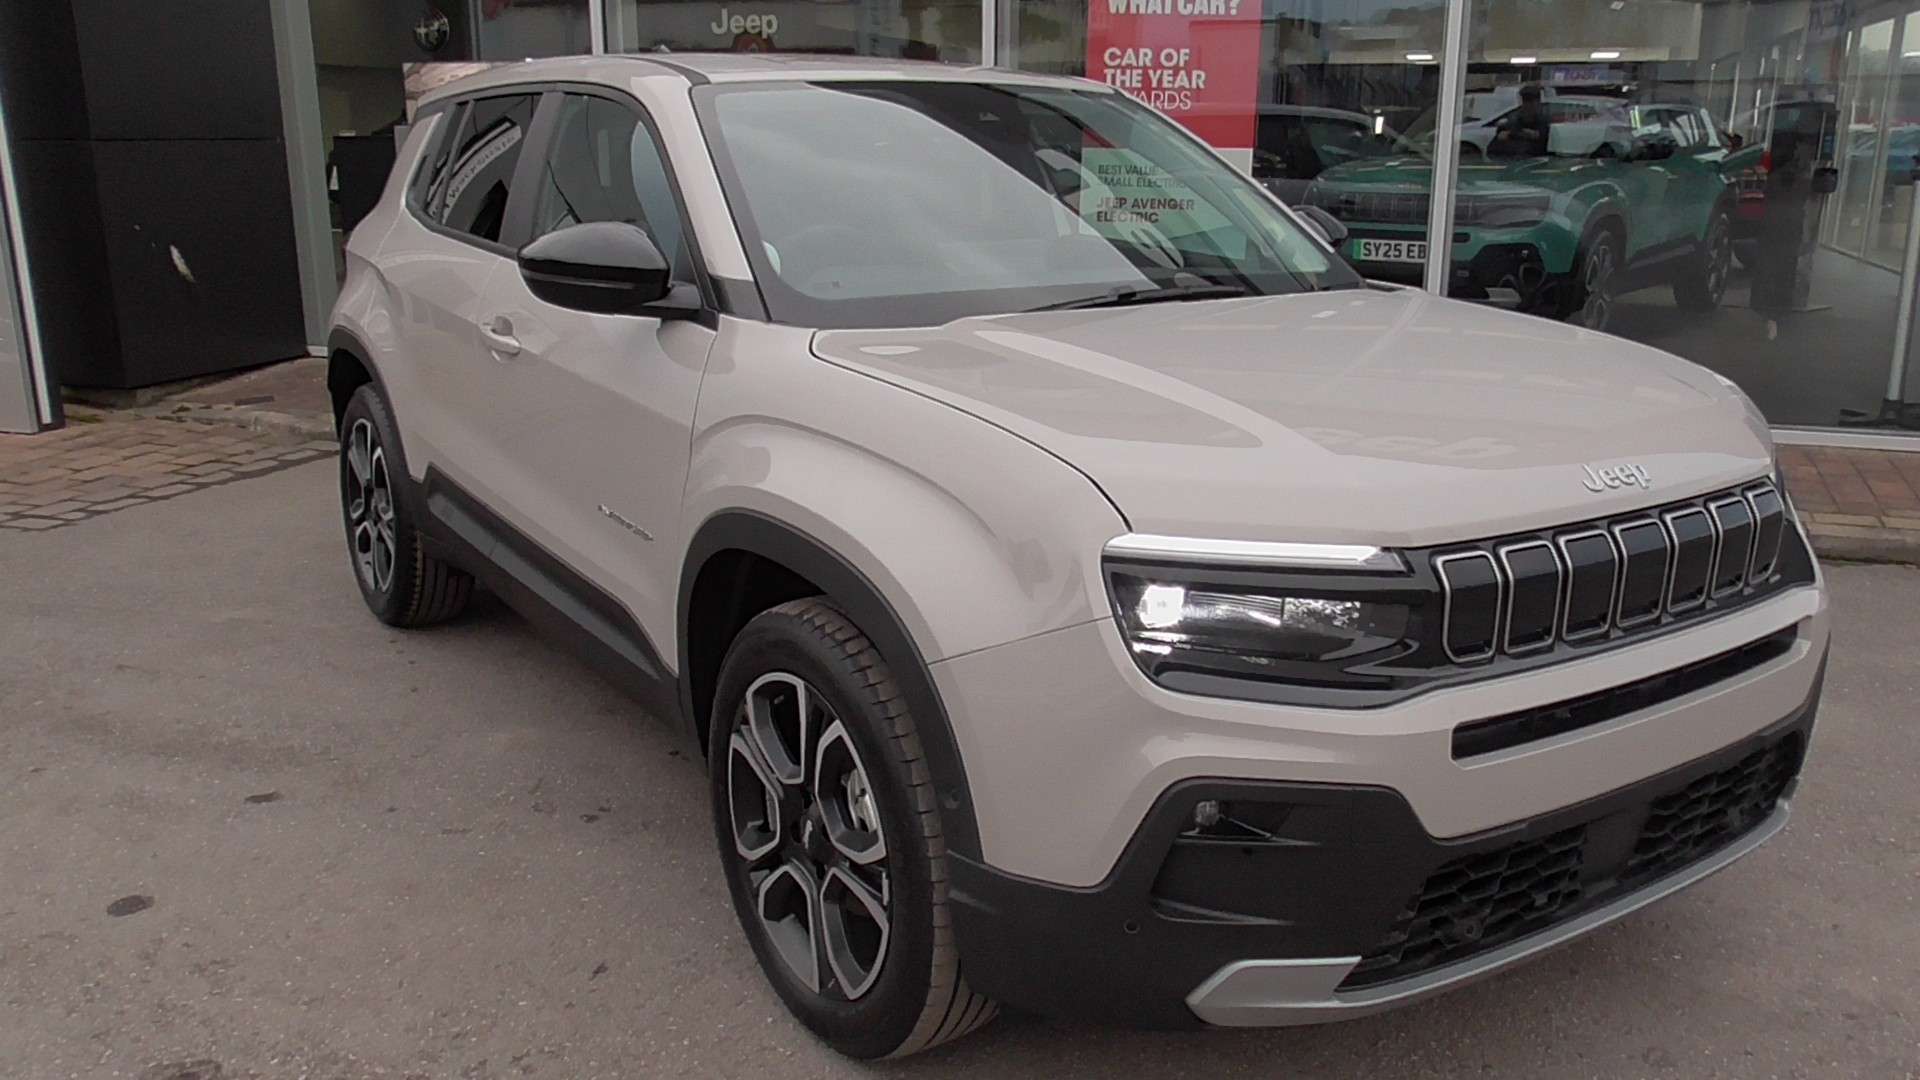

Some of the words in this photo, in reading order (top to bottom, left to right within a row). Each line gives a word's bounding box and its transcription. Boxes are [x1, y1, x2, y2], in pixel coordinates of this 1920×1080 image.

[711, 8, 778, 39] Jeep
[1103, 47, 1153, 67] CAR
[1160, 48, 1190, 67] OF
[1103, 68, 1143, 88] THE
[1148, 69, 1206, 89] YEAR
[1133, 89, 1192, 110] ARDS
[1097, 164, 1122, 175] BEST
[1096, 197, 1128, 208] JEEP
[1131, 198, 1195, 210] AVENGER
[1096, 211, 1160, 223] ELECTRIC
[1362, 241, 1402, 258] SY25
[1581, 463, 1652, 492] Jeep
